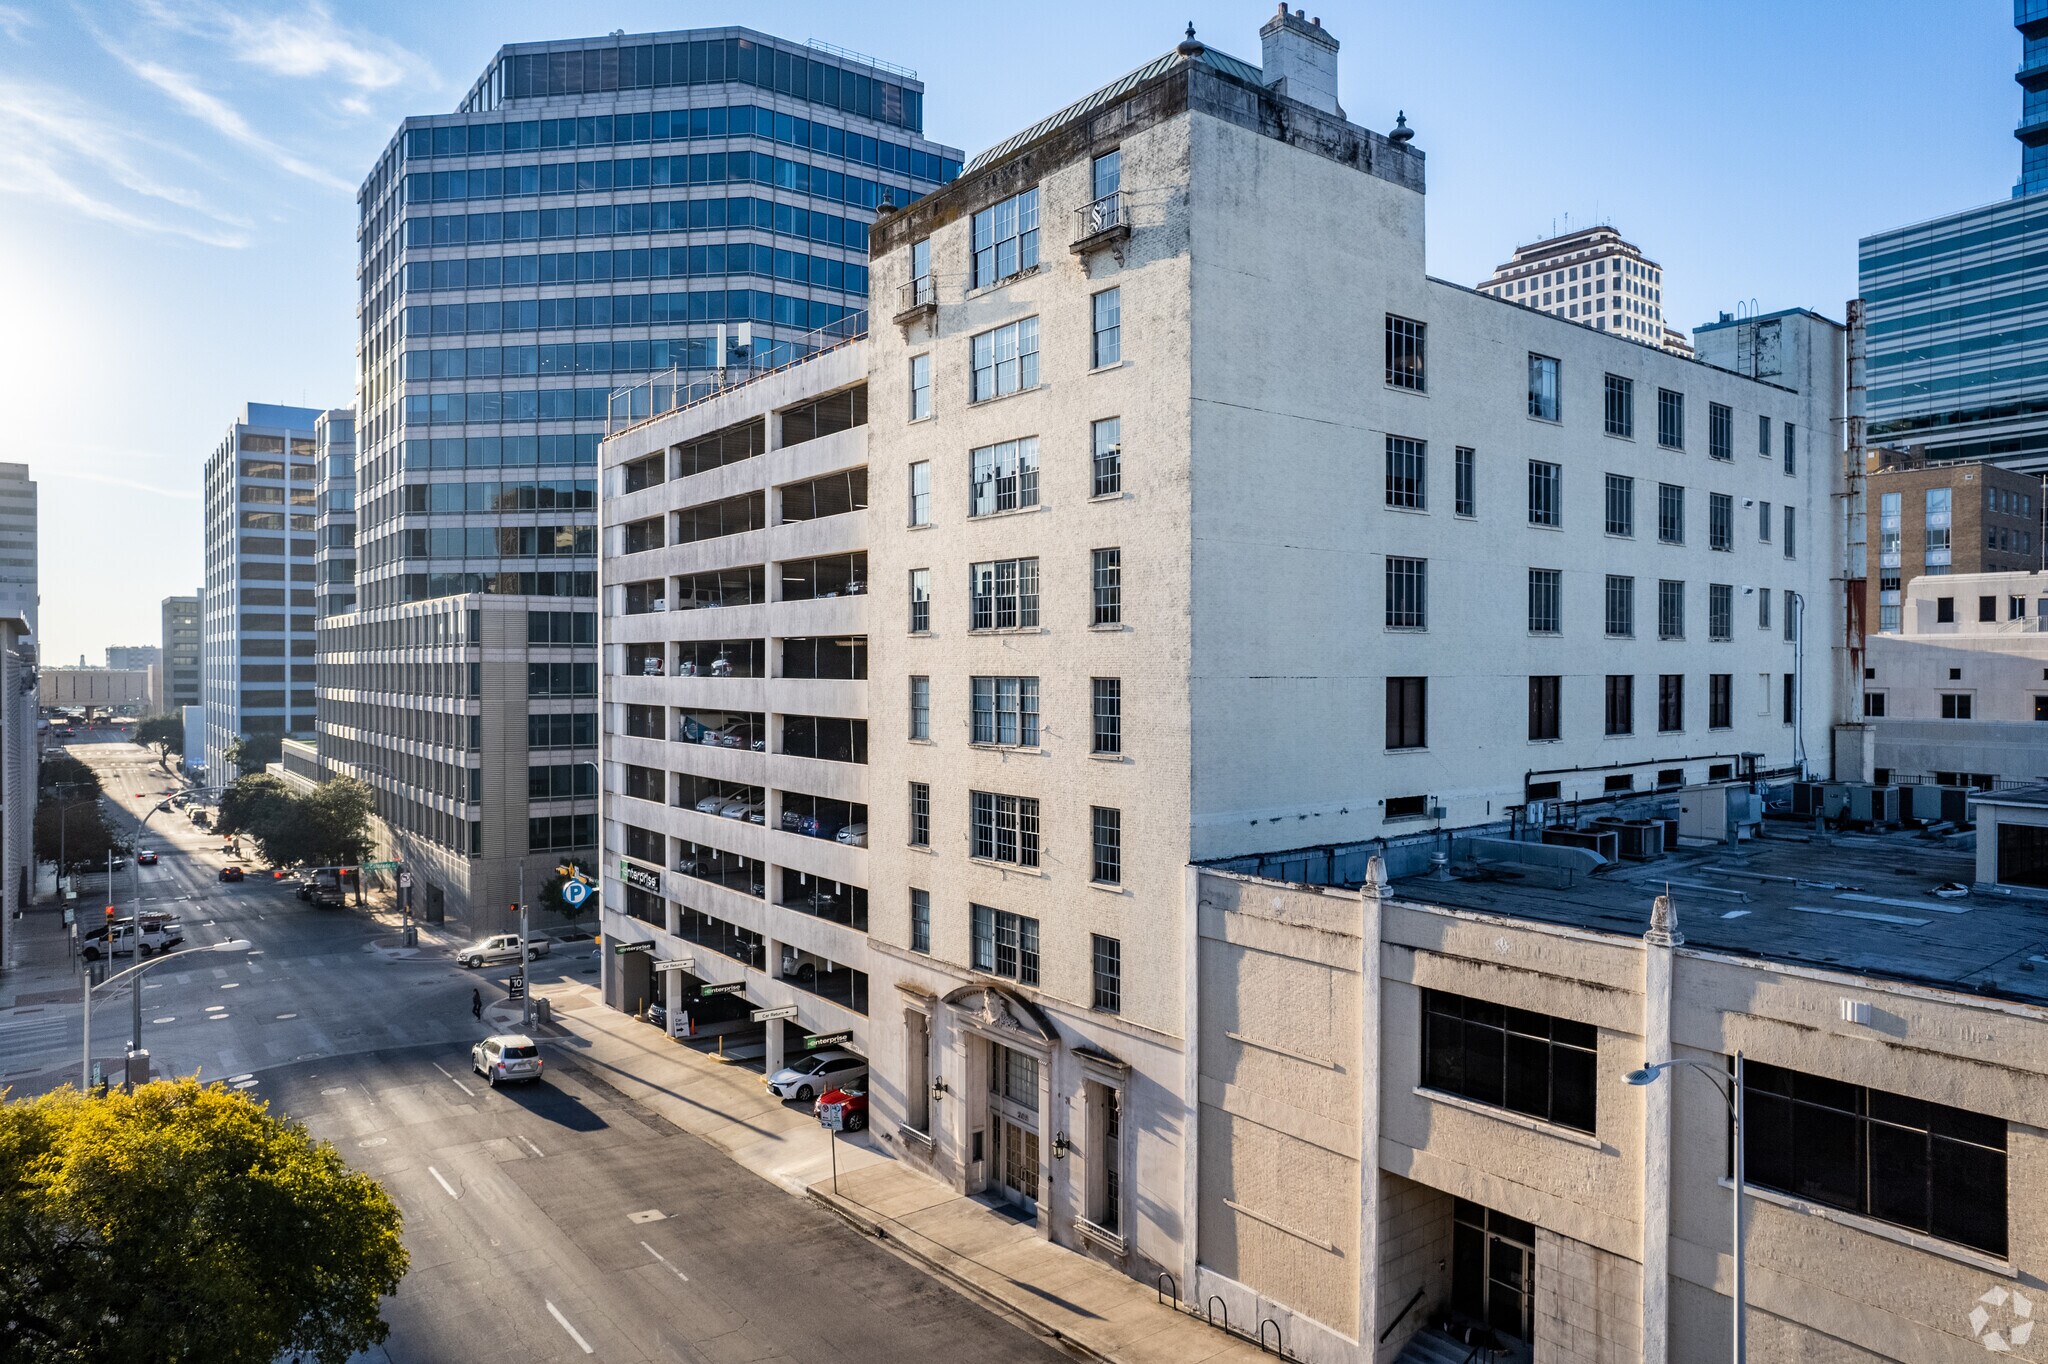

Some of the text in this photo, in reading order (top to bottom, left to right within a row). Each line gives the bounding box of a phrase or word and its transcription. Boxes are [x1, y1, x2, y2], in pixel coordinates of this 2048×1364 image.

[621, 866, 656, 888] enterprise
[570, 885, 582, 902] P
[619, 944, 651, 953] enterprise
[705, 985, 741, 994] enterprise
[770, 1010, 785, 1018] Return
[808, 1034, 848, 1046] enterprise
